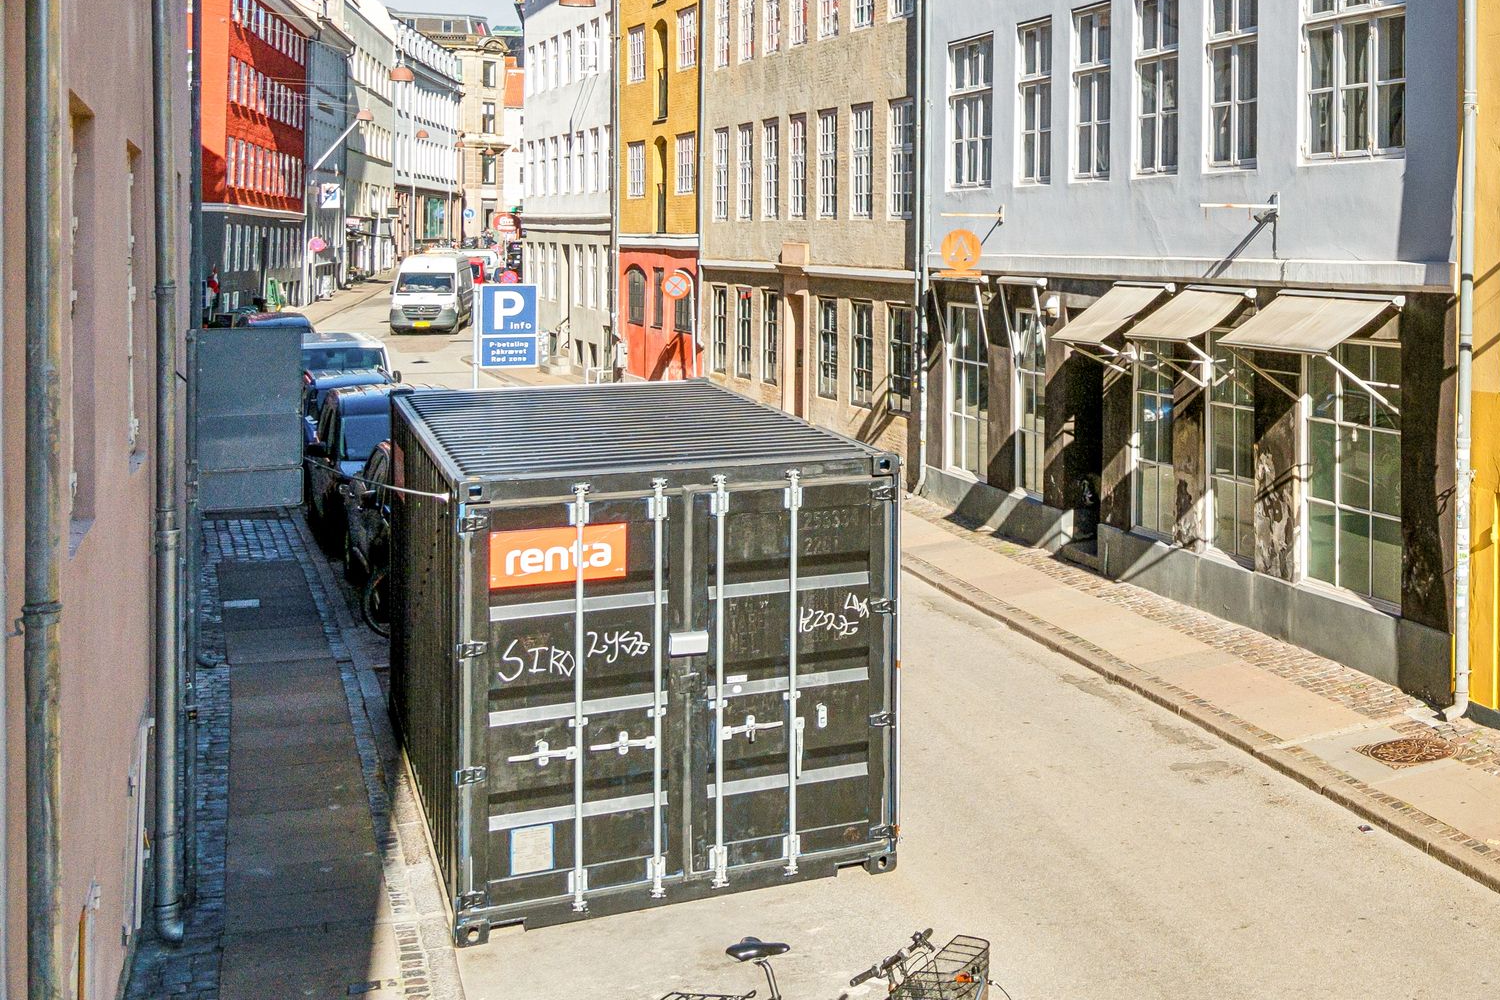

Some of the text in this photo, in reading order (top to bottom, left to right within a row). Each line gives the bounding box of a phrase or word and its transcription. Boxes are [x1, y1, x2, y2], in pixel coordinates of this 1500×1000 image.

[494, 290, 525, 330] P
[491, 348, 527, 356] påkrævet
[505, 539, 612, 576] renta
